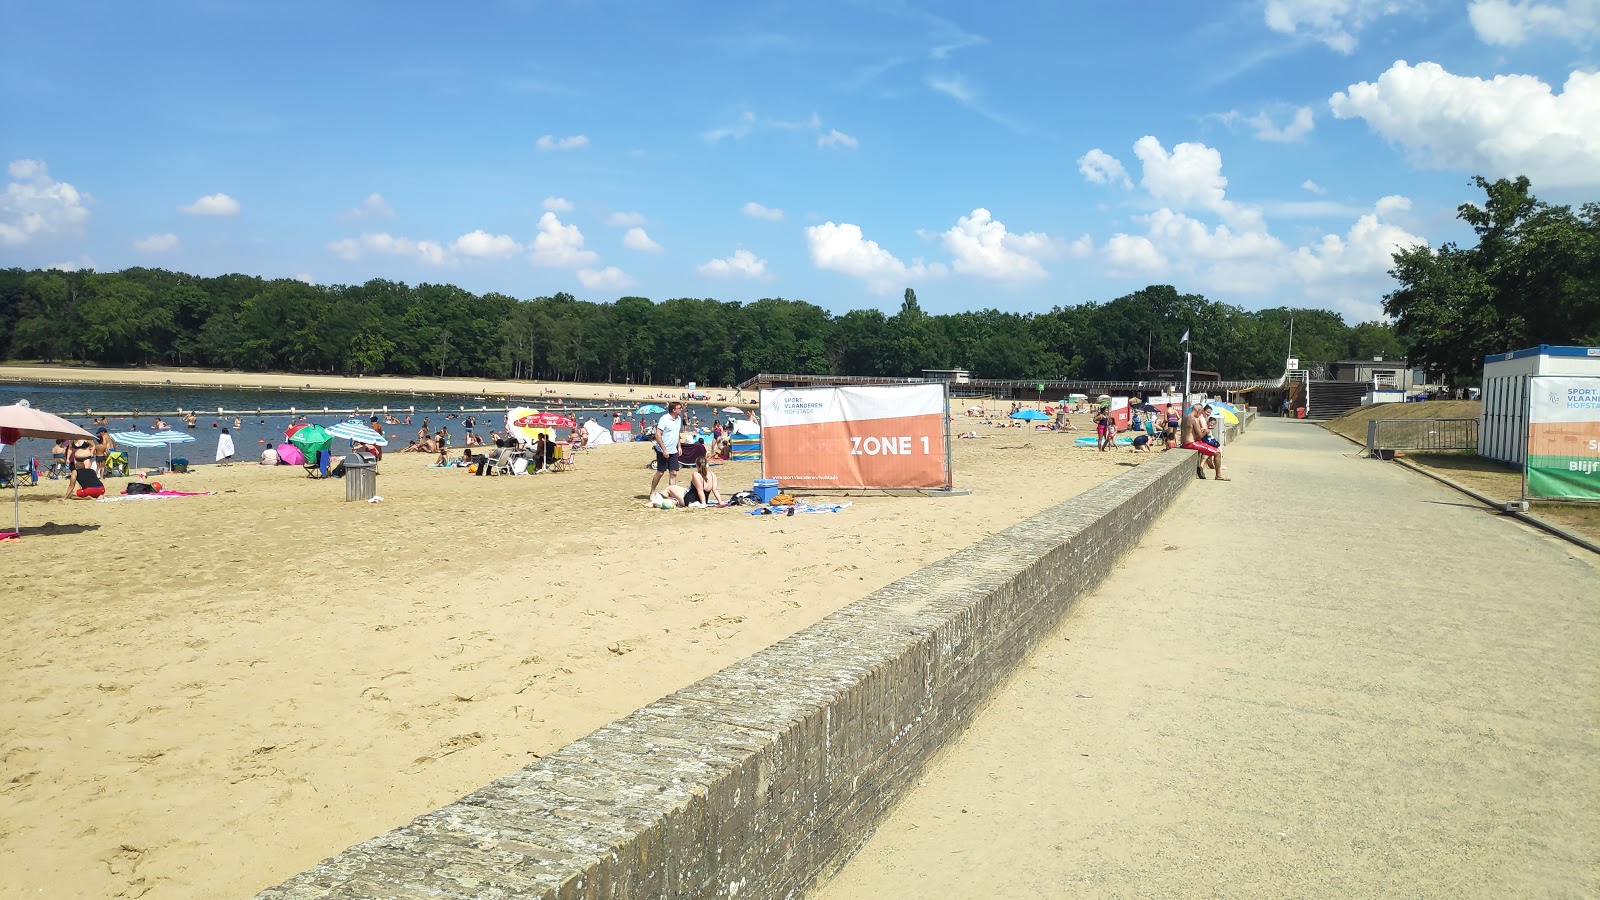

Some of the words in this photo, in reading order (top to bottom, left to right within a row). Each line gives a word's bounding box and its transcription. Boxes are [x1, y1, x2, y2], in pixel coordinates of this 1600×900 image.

[850, 436, 912, 456] ZONE
[920, 436, 930, 455] 1
[1569, 461, 1600, 474] Blijf
